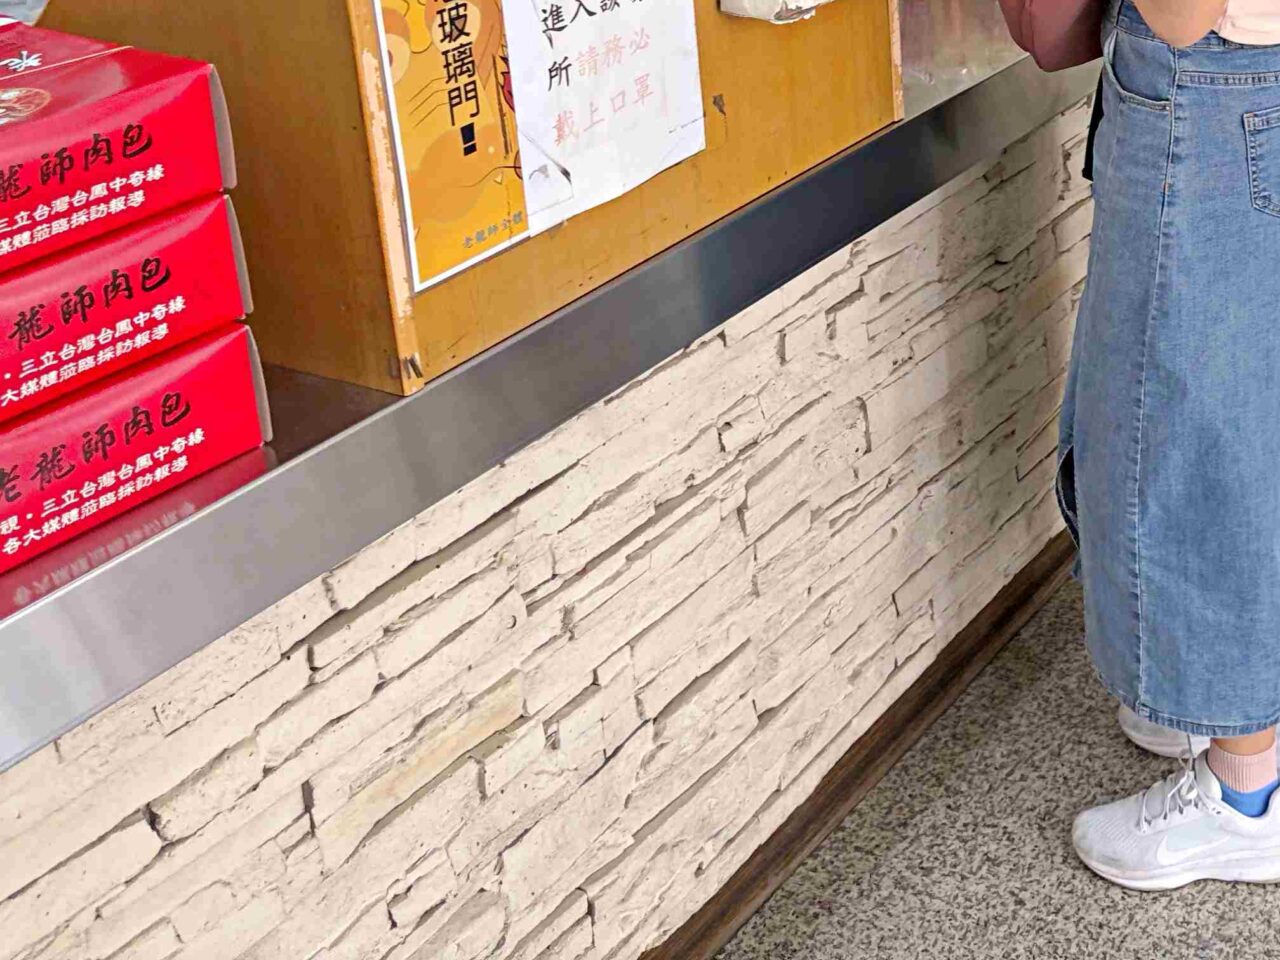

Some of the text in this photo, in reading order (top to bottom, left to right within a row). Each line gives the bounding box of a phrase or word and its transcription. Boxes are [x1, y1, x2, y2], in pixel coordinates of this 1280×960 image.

[548, 27, 650, 92] 所請務必
[553, 72, 655, 147] 戴上口罩
